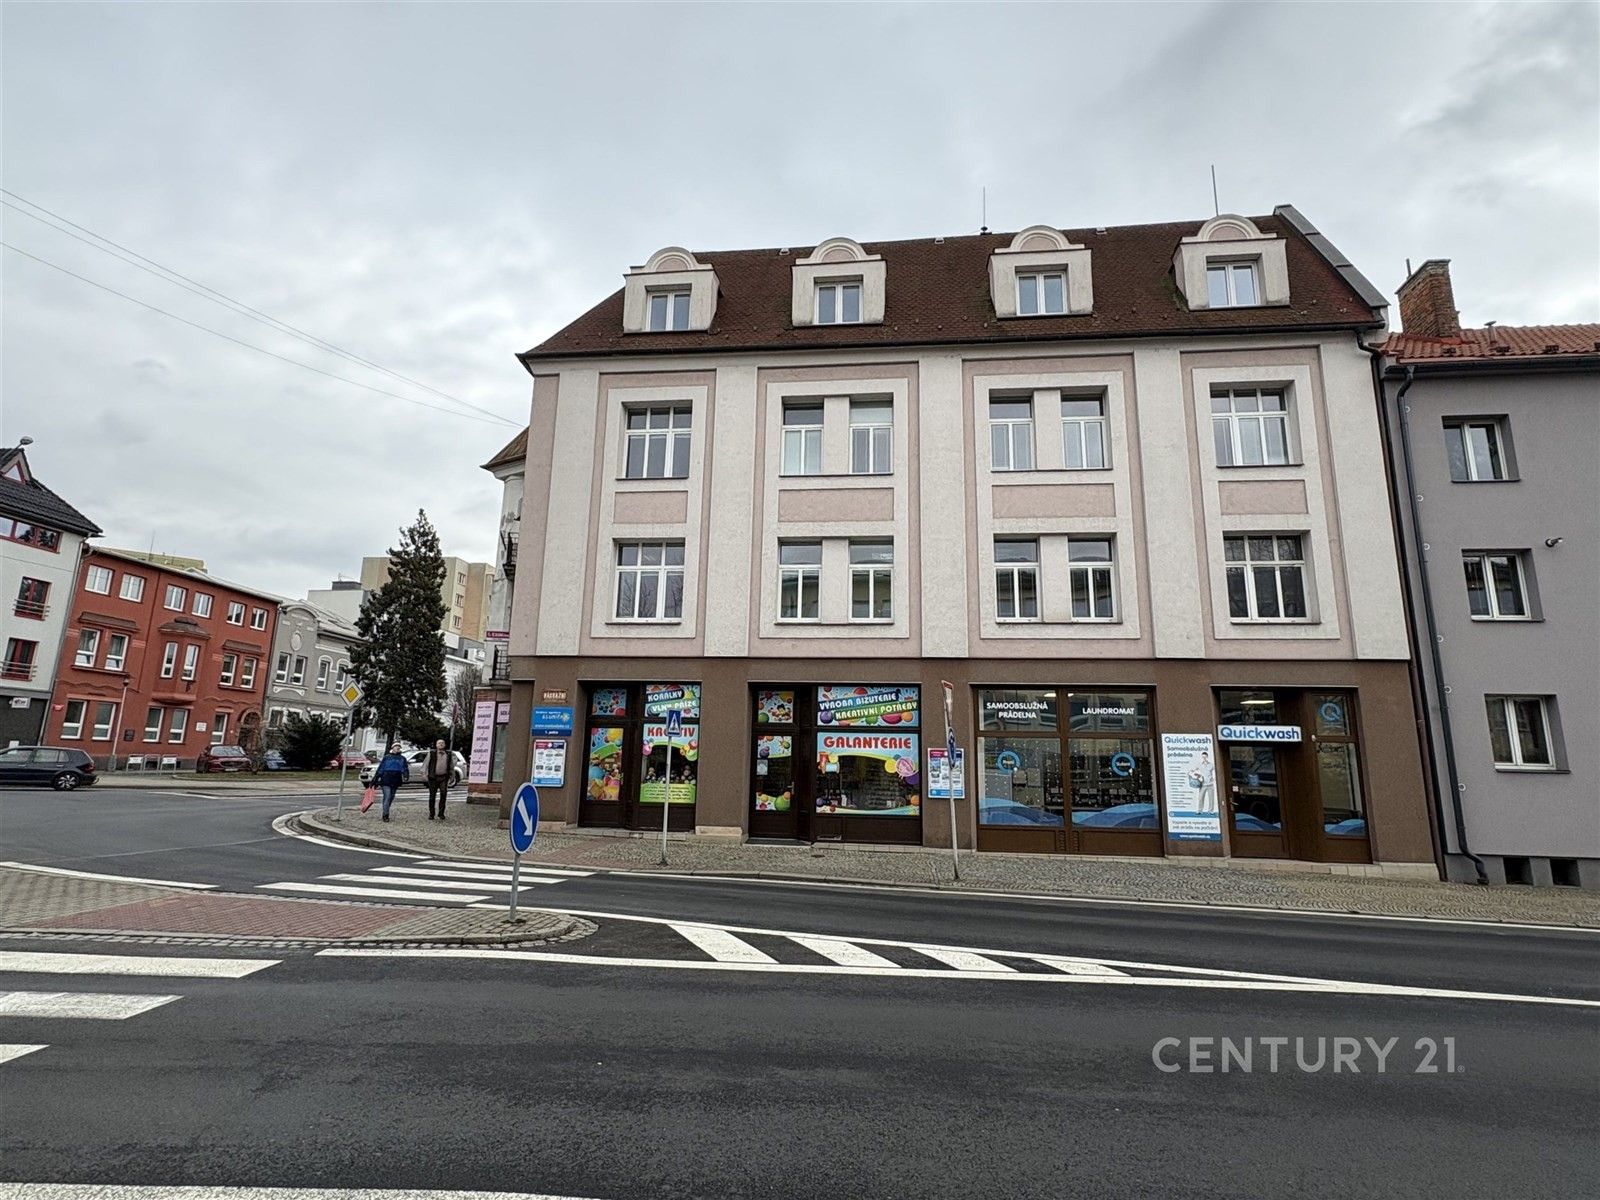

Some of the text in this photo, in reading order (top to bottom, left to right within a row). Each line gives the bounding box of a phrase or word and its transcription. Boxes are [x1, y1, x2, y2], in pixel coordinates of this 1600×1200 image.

[986, 701, 1049, 710] SAMOOBSLUŽNÁ
[998, 710, 1037, 720] PRÁDELNA
[1082, 707, 1135, 715] LAUNDROMAT
[1220, 727, 1299, 739] Quickwash
[823, 736, 911, 749] GALANTERIE
[1164, 736, 1211, 744] Quickwash
